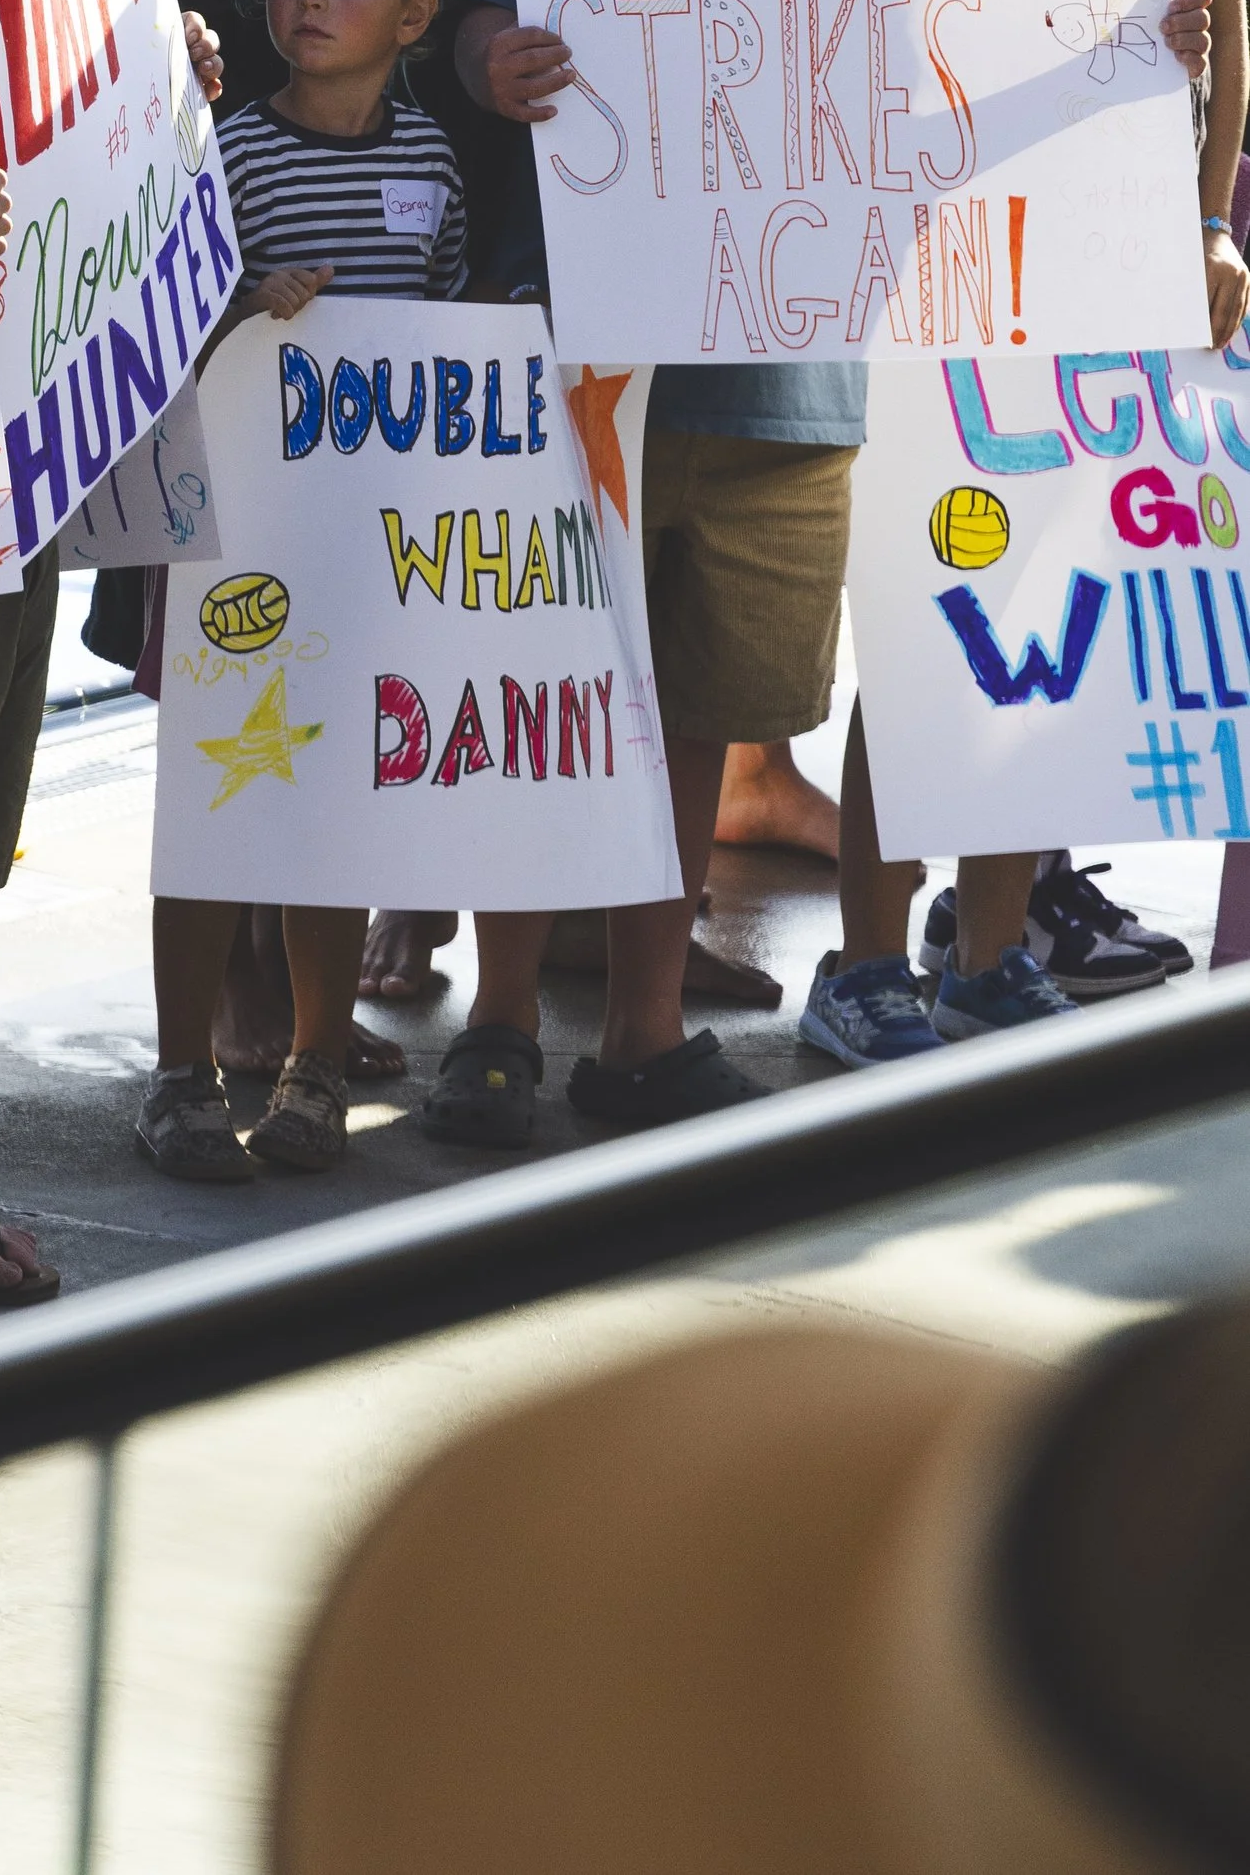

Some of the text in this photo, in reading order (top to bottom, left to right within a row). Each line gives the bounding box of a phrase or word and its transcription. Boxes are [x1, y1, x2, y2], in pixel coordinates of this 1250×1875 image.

[701, 195, 1027, 353] AGAIN!
[4, 172, 234, 558] HUNTER
[279, 342, 548, 461] DOUBLE
[379, 497, 613, 612] WHAMM
[1109, 466, 1240, 550] GO
[374, 669, 615, 790] DANNY
